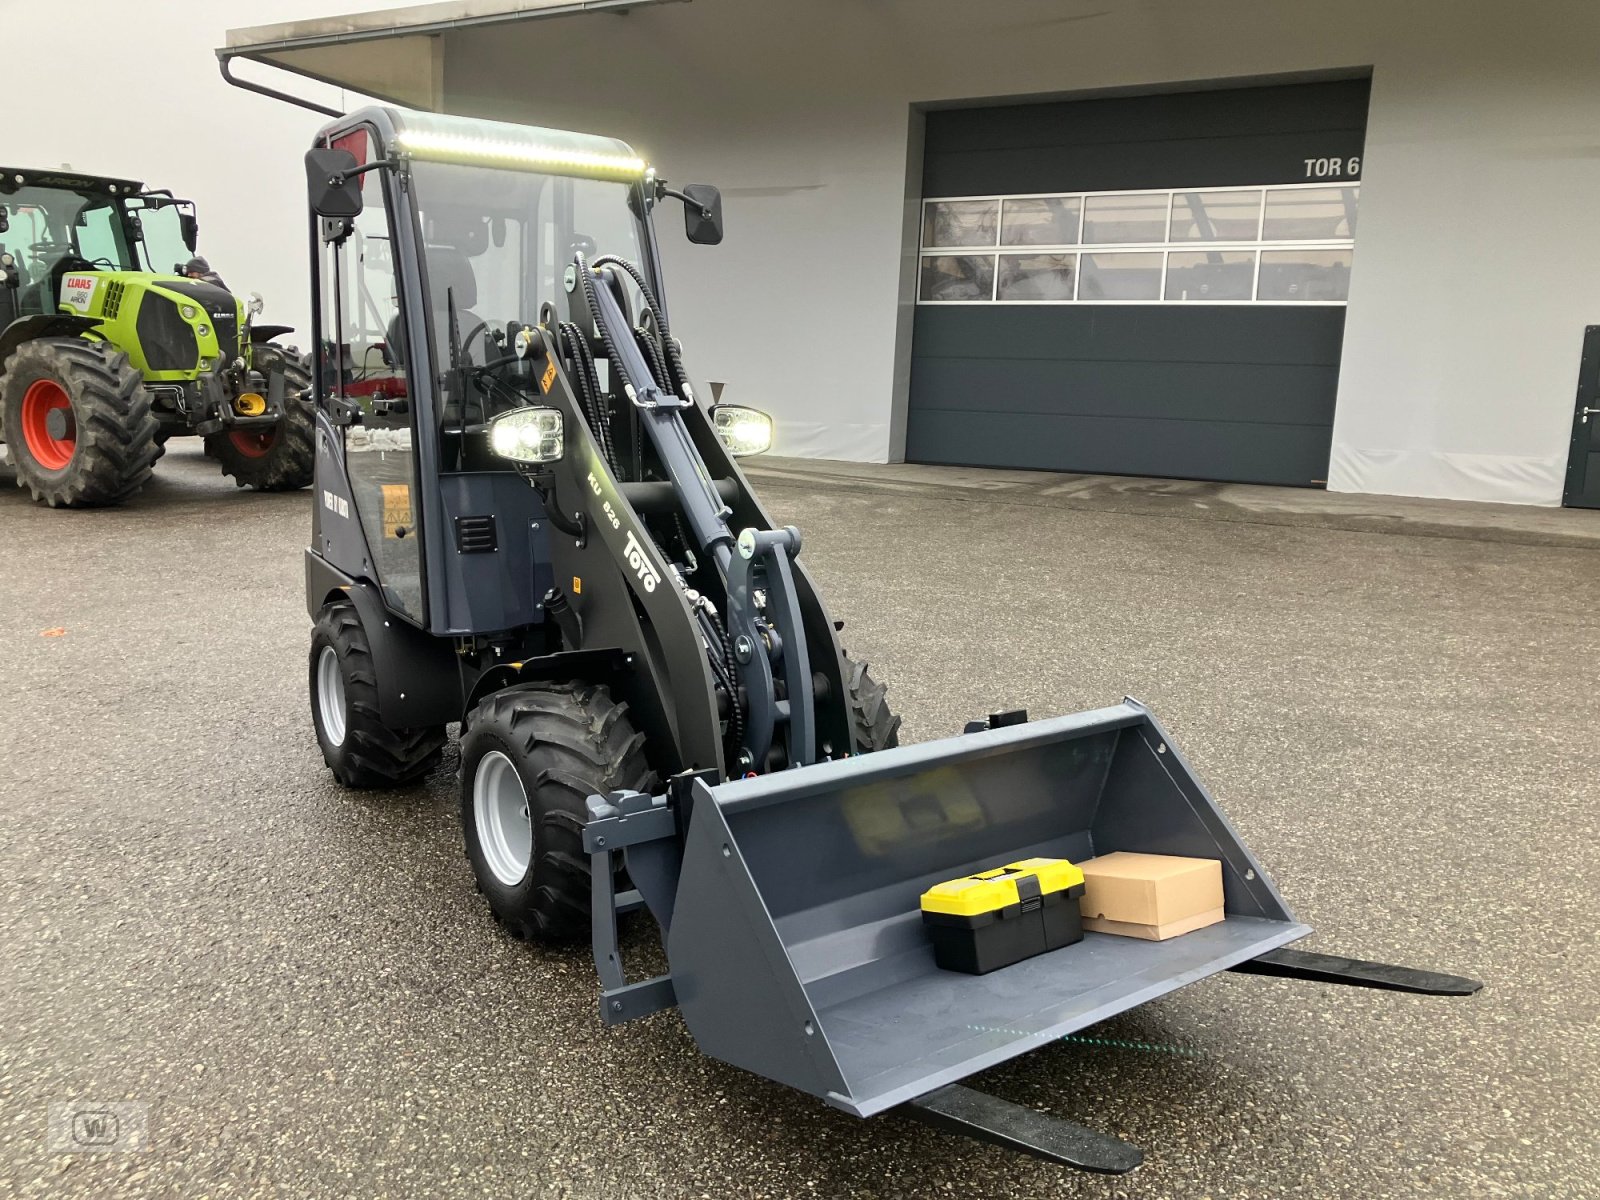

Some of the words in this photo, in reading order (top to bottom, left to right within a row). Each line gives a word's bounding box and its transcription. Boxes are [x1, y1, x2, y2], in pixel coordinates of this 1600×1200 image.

[1304, 157, 1341, 177] TOR
[1347, 156, 1360, 176] 6
[67, 277, 92, 290] CLAAS
[587, 472, 602, 496] KU
[602, 501, 621, 530] 826
